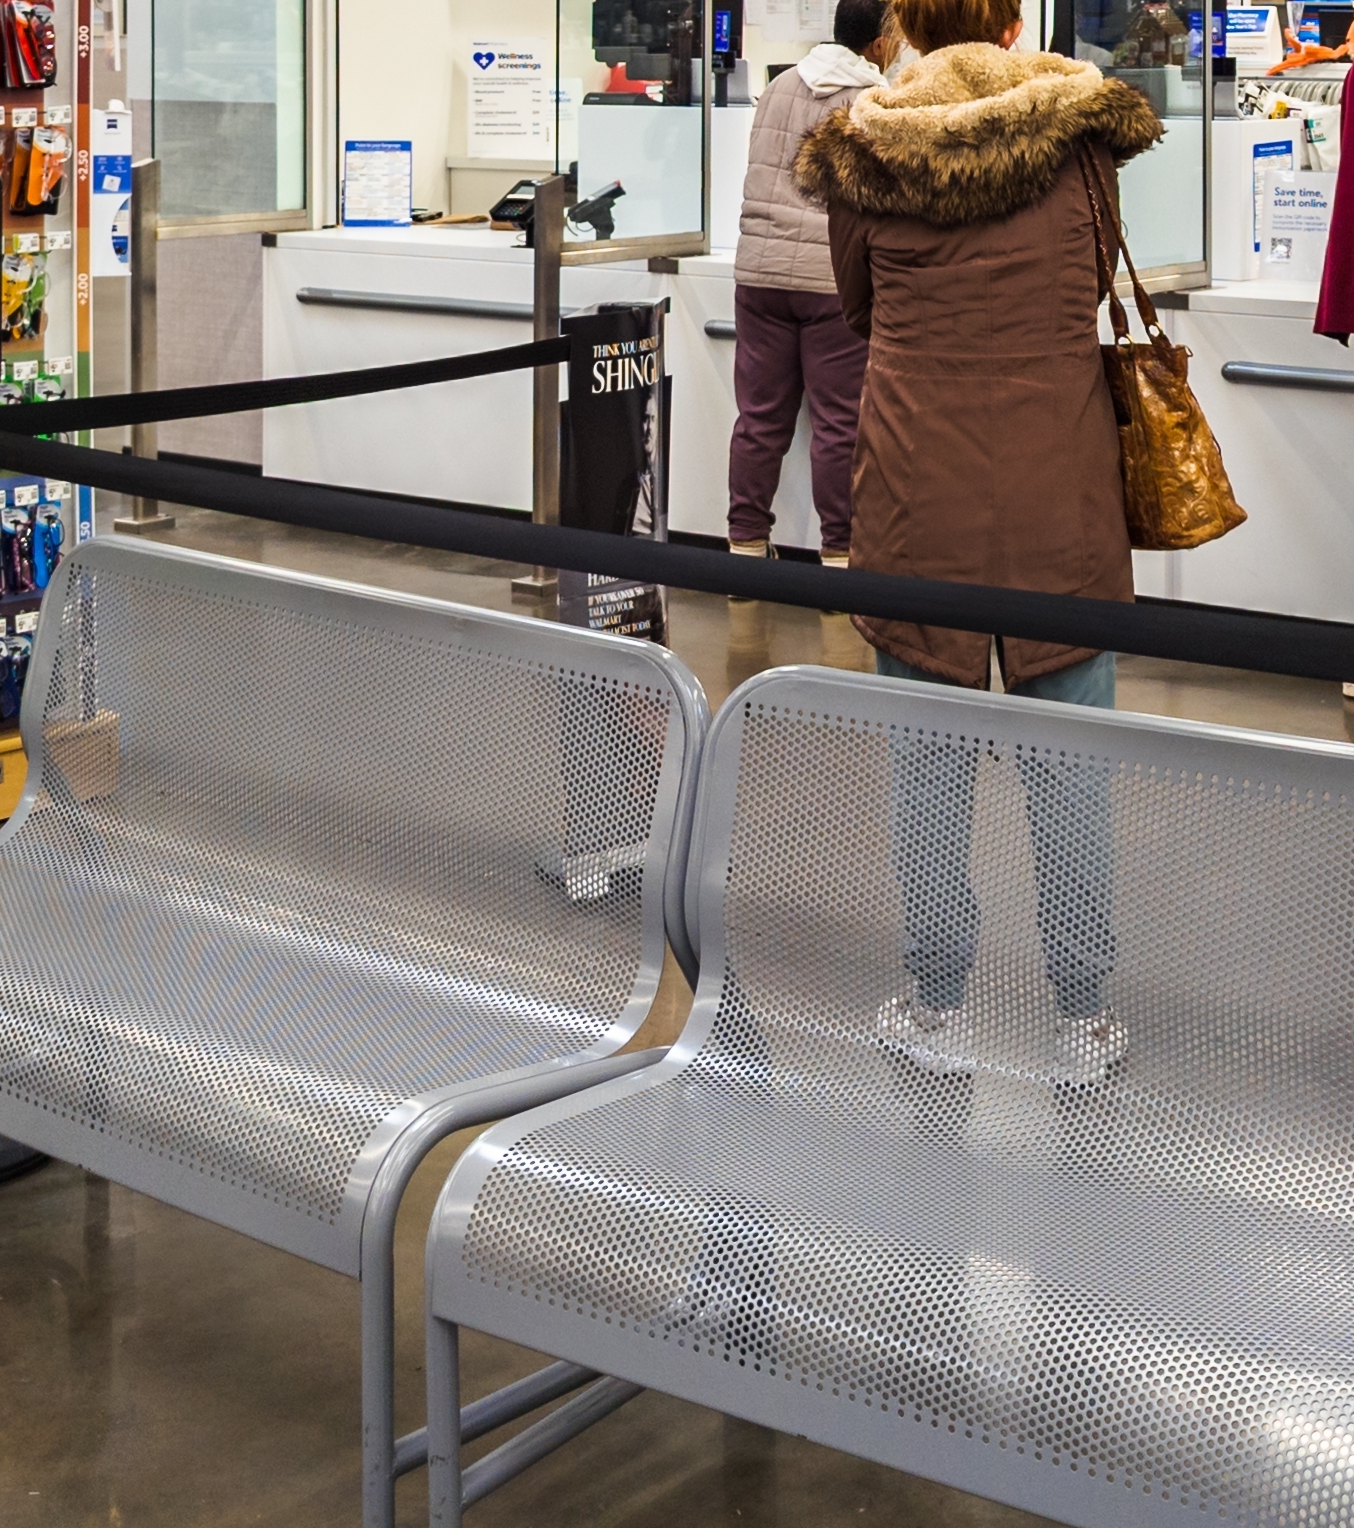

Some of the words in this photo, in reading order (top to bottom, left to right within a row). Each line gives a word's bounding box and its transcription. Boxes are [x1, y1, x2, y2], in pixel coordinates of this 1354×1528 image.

[78, 25, 90, 59] +3.00
[78, 149, 90, 182] +2.50
[1273, 198, 1296, 208] start
[1298, 198, 1328, 208] online
[1274, 187, 1297, 197] Save
[77, 272, 90, 306] +2.00
